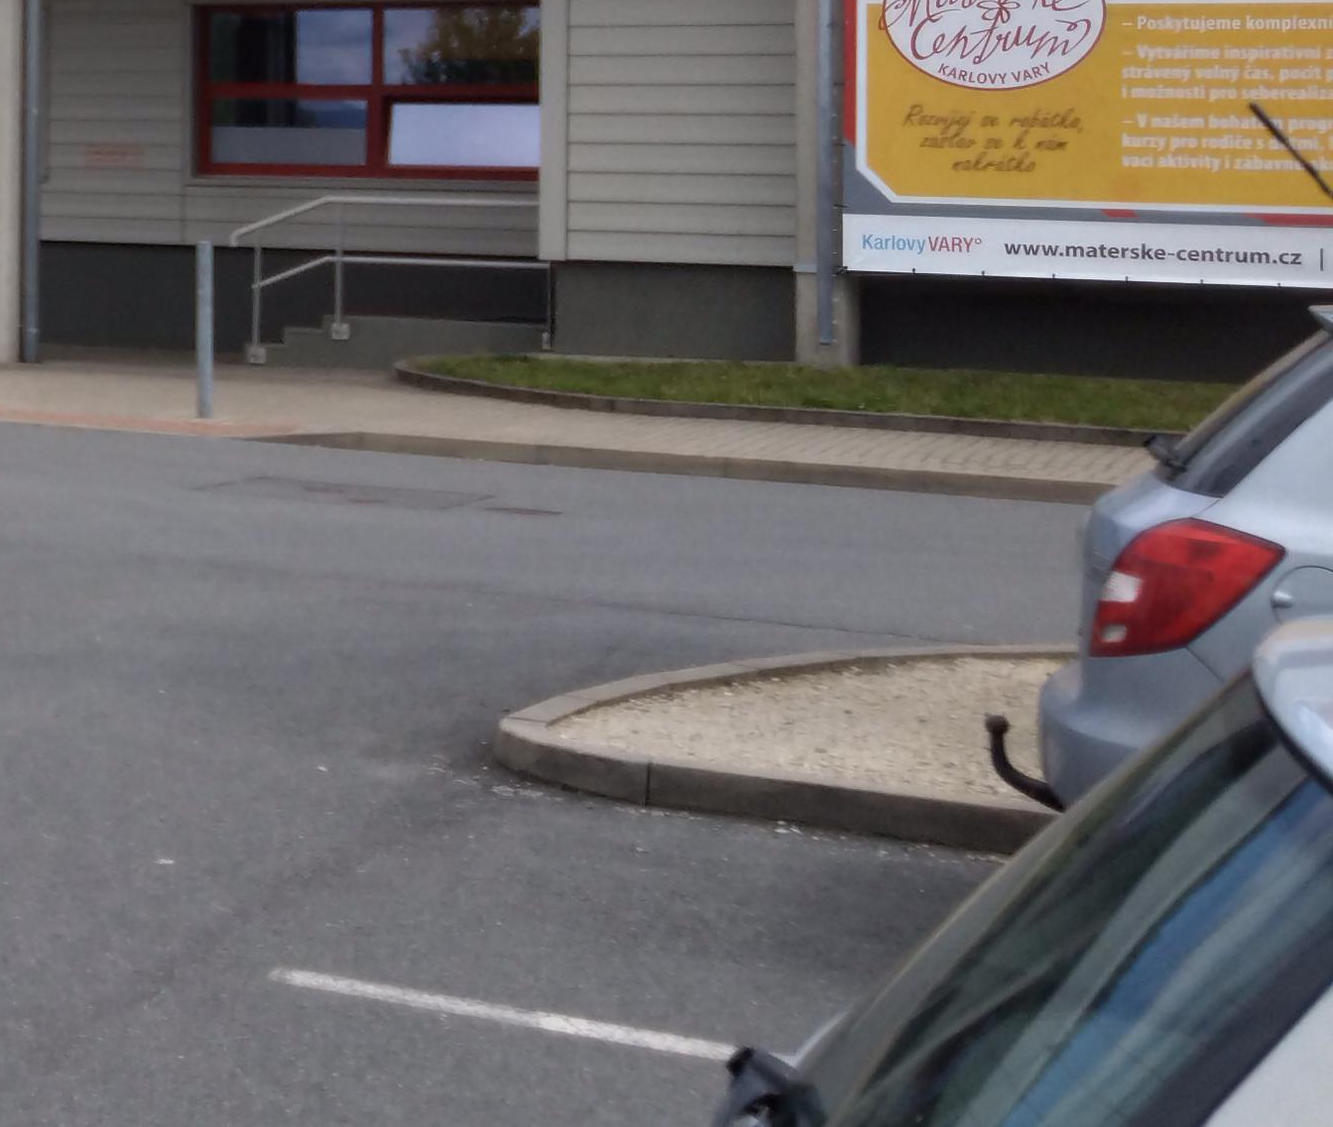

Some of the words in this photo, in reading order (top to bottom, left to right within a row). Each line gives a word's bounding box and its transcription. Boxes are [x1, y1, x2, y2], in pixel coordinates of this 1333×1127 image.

[1137, 16, 1241, 32] Poskytujeme
[910, 8, 1091, 66] Centrum
[938, 63, 1007, 84] KARLOVY
[1011, 62, 1051, 83] VARY
[1004, 241, 1302, 266] www.materske-centrum.cz
